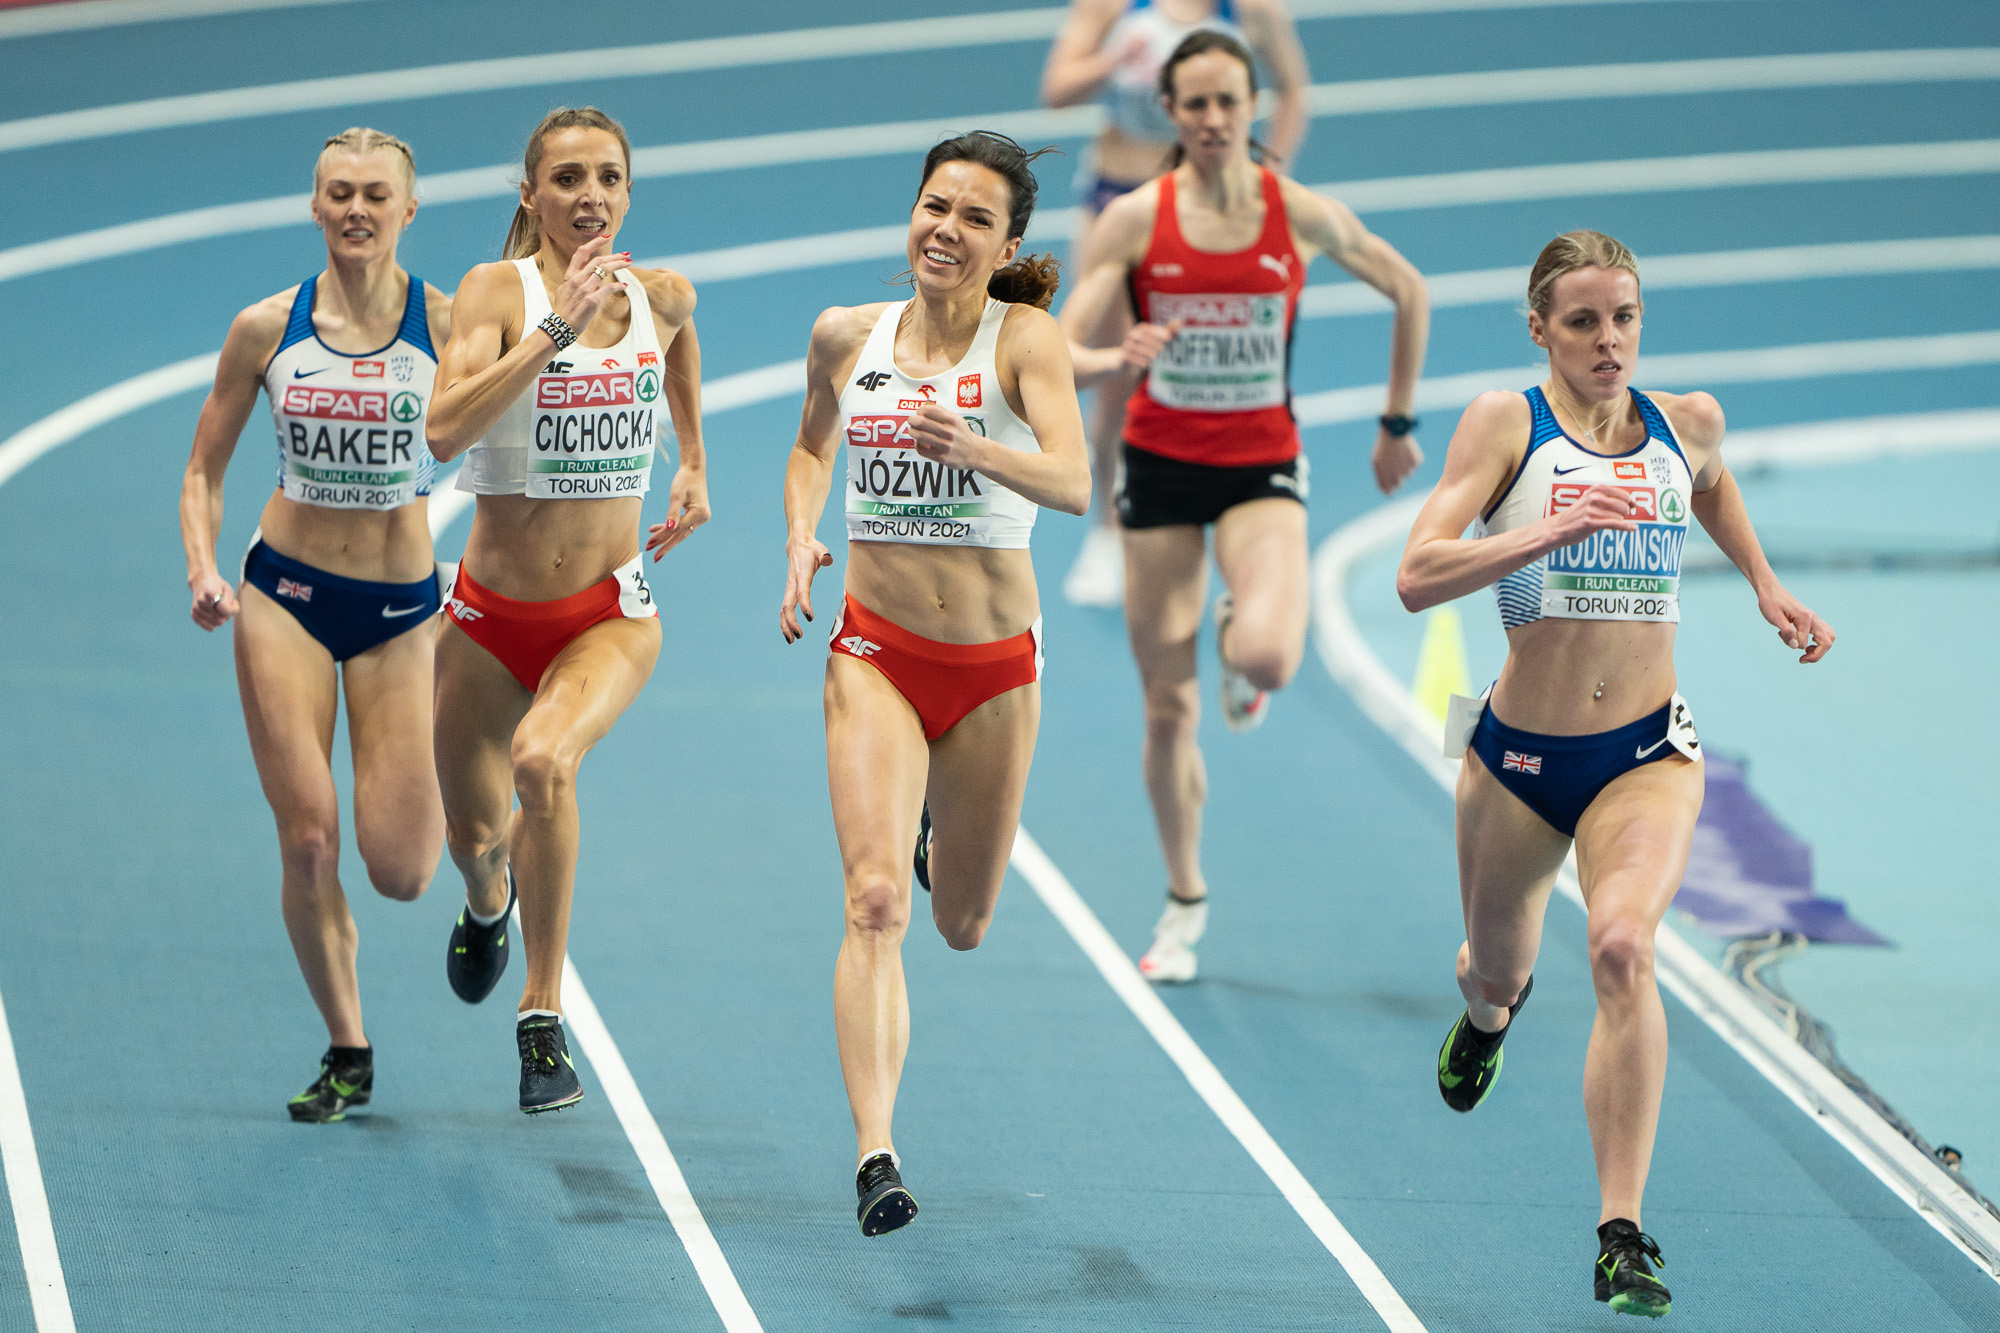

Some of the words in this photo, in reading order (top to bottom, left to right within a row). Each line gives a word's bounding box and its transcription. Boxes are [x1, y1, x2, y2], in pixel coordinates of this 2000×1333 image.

[1162, 333, 1279, 366] OFFMANN
[541, 377, 632, 404] SPAR
[856, 371, 892, 391] 4F
[285, 389, 385, 418] SPAR
[900, 401, 927, 410] ORLE
[535, 408, 653, 454] CICHOCKA
[850, 419, 915, 444] SPA
[289, 421, 413, 465] BAKER
[314, 469, 342, 482] RUN
[559, 461, 564, 472] I
[567, 461, 595, 472] RUN
[855, 450, 982, 499] JÓŹWIK
[301, 482, 360, 504] TORUŃ
[365, 488, 400, 505] 2021
[548, 475, 611, 494] TORUŃ
[872, 503, 878, 514] I
[879, 505, 905, 516] RUN
[1553, 488, 1655, 516] SR
[862, 519, 925, 537] TORUŃ
[929, 522, 971, 538] 2021
[1577, 578, 1581, 589] I
[1584, 578, 1613, 590] RUN
[450, 597, 484, 621] 4F
[1564, 595, 1629, 615] TORUŃ
[840, 635, 882, 657] 4F
